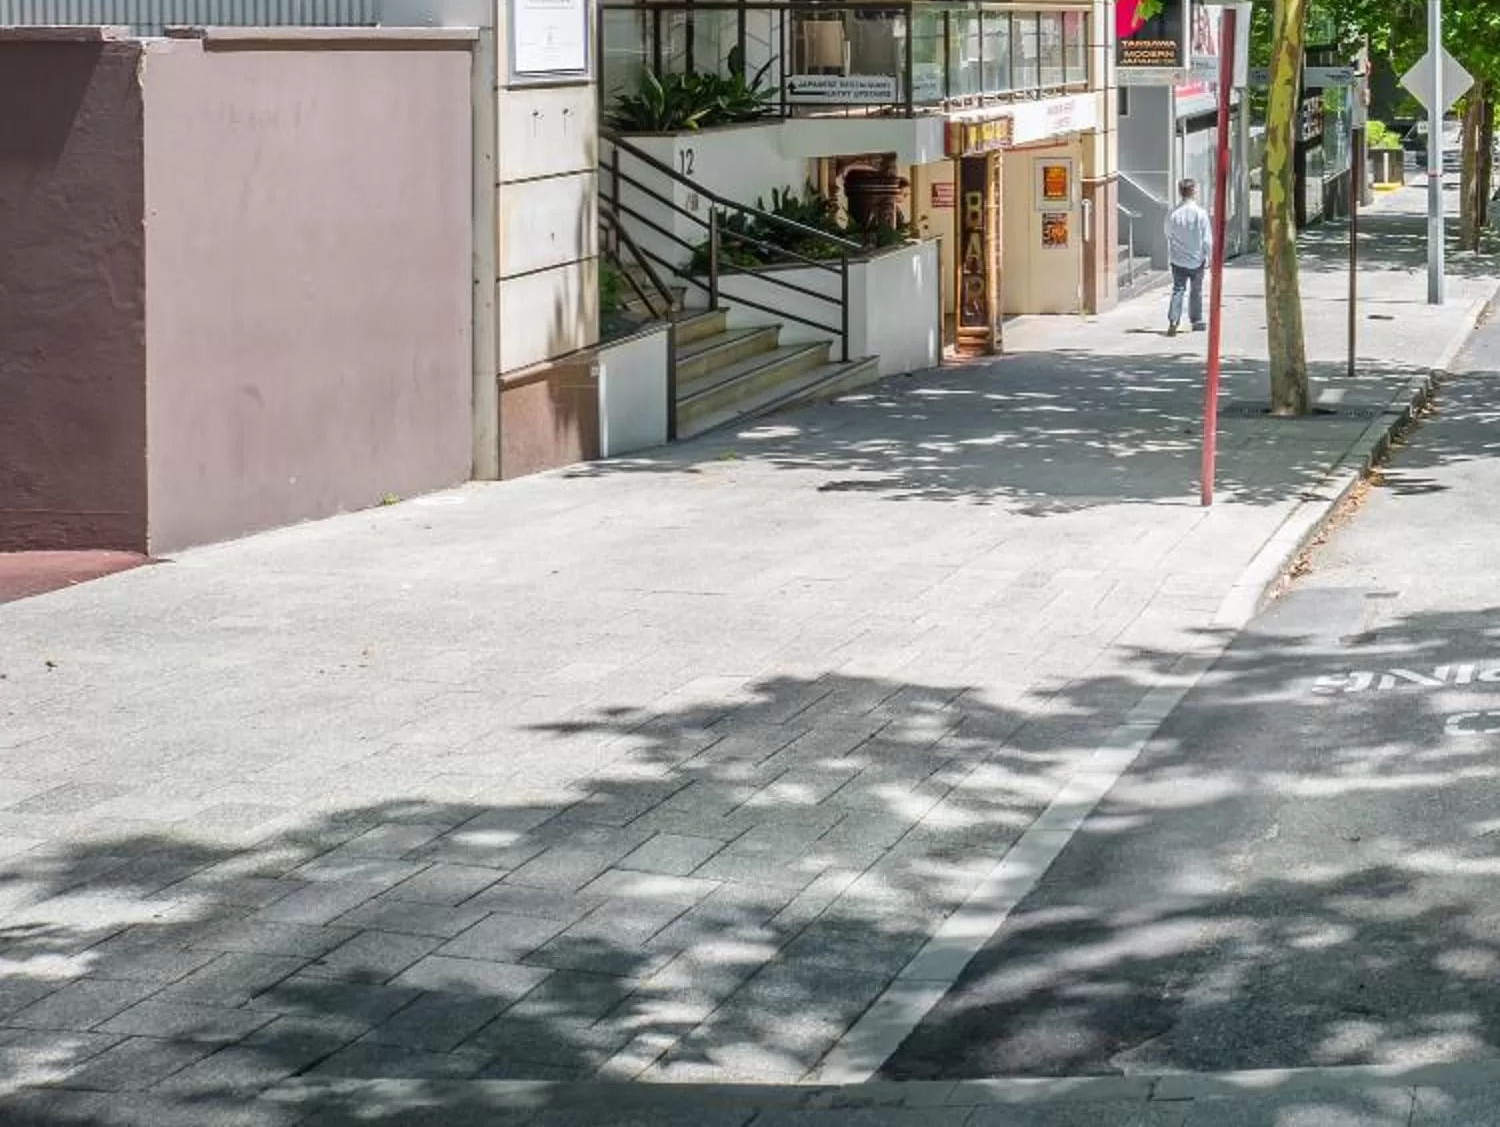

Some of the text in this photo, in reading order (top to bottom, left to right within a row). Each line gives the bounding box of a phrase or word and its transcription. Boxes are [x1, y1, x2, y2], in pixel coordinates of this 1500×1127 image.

[1123, 50, 1175, 59] MODERN
[680, 148, 695, 177] 12
[963, 191, 987, 318] BAR
